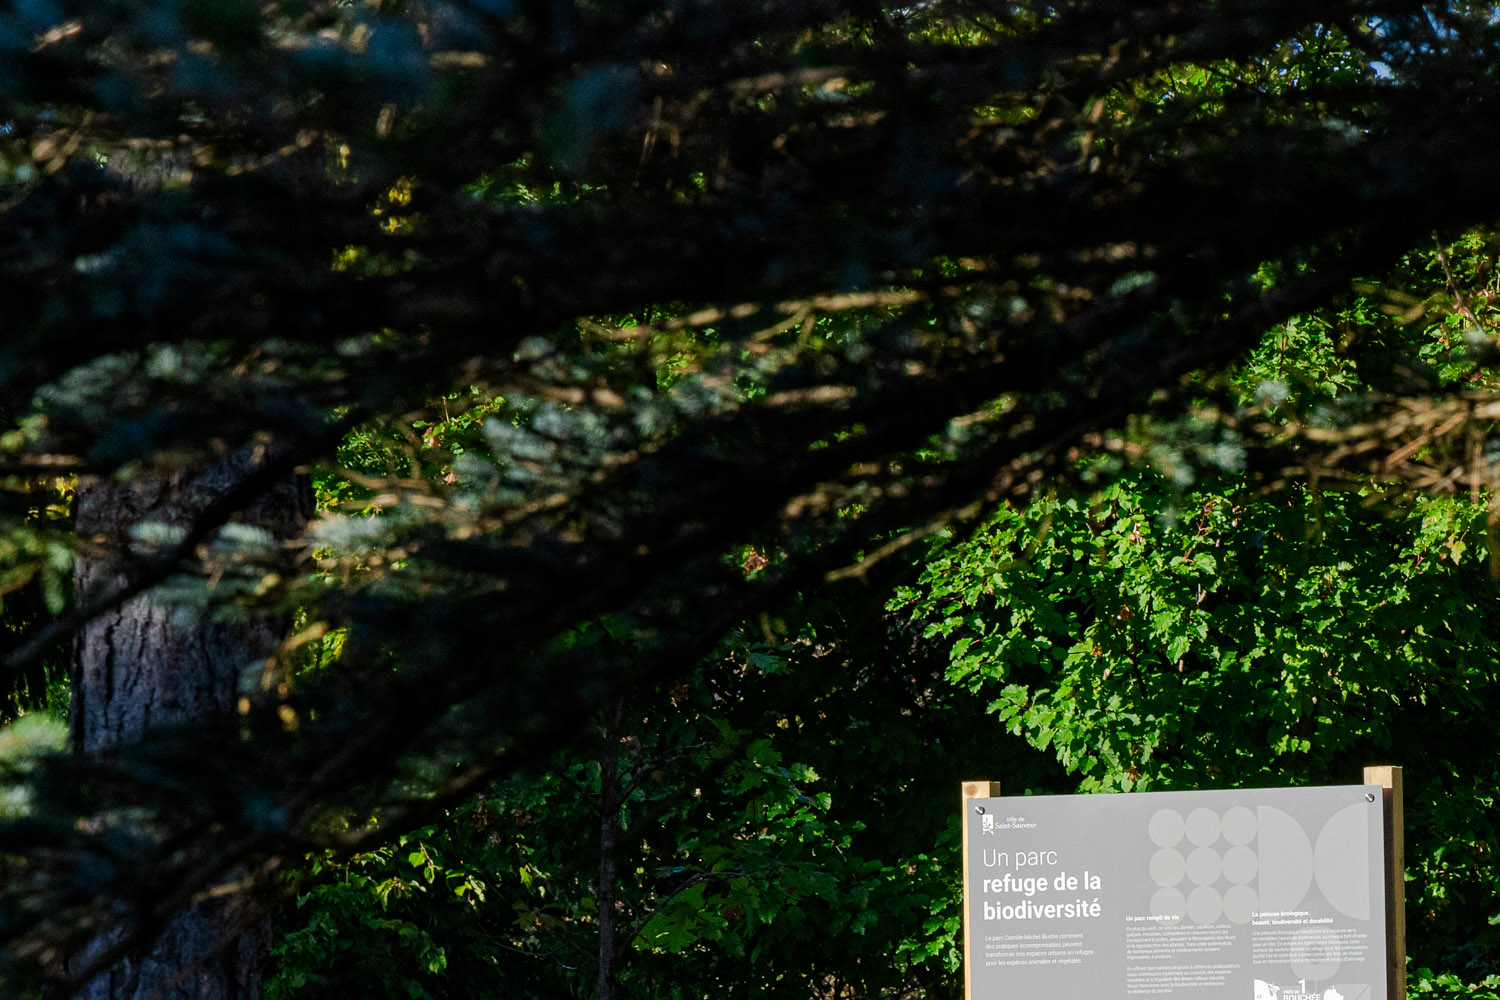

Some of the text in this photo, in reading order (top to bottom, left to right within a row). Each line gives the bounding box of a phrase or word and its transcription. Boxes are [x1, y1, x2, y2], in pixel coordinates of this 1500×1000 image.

[995, 822, 1037, 830] Saint-Sauveur
[984, 849, 1058, 871] Un parc
[984, 870, 1101, 897] refuge de la
[983, 898, 1101, 920] biodiversité
[1298, 979, 1306, 993] 1
